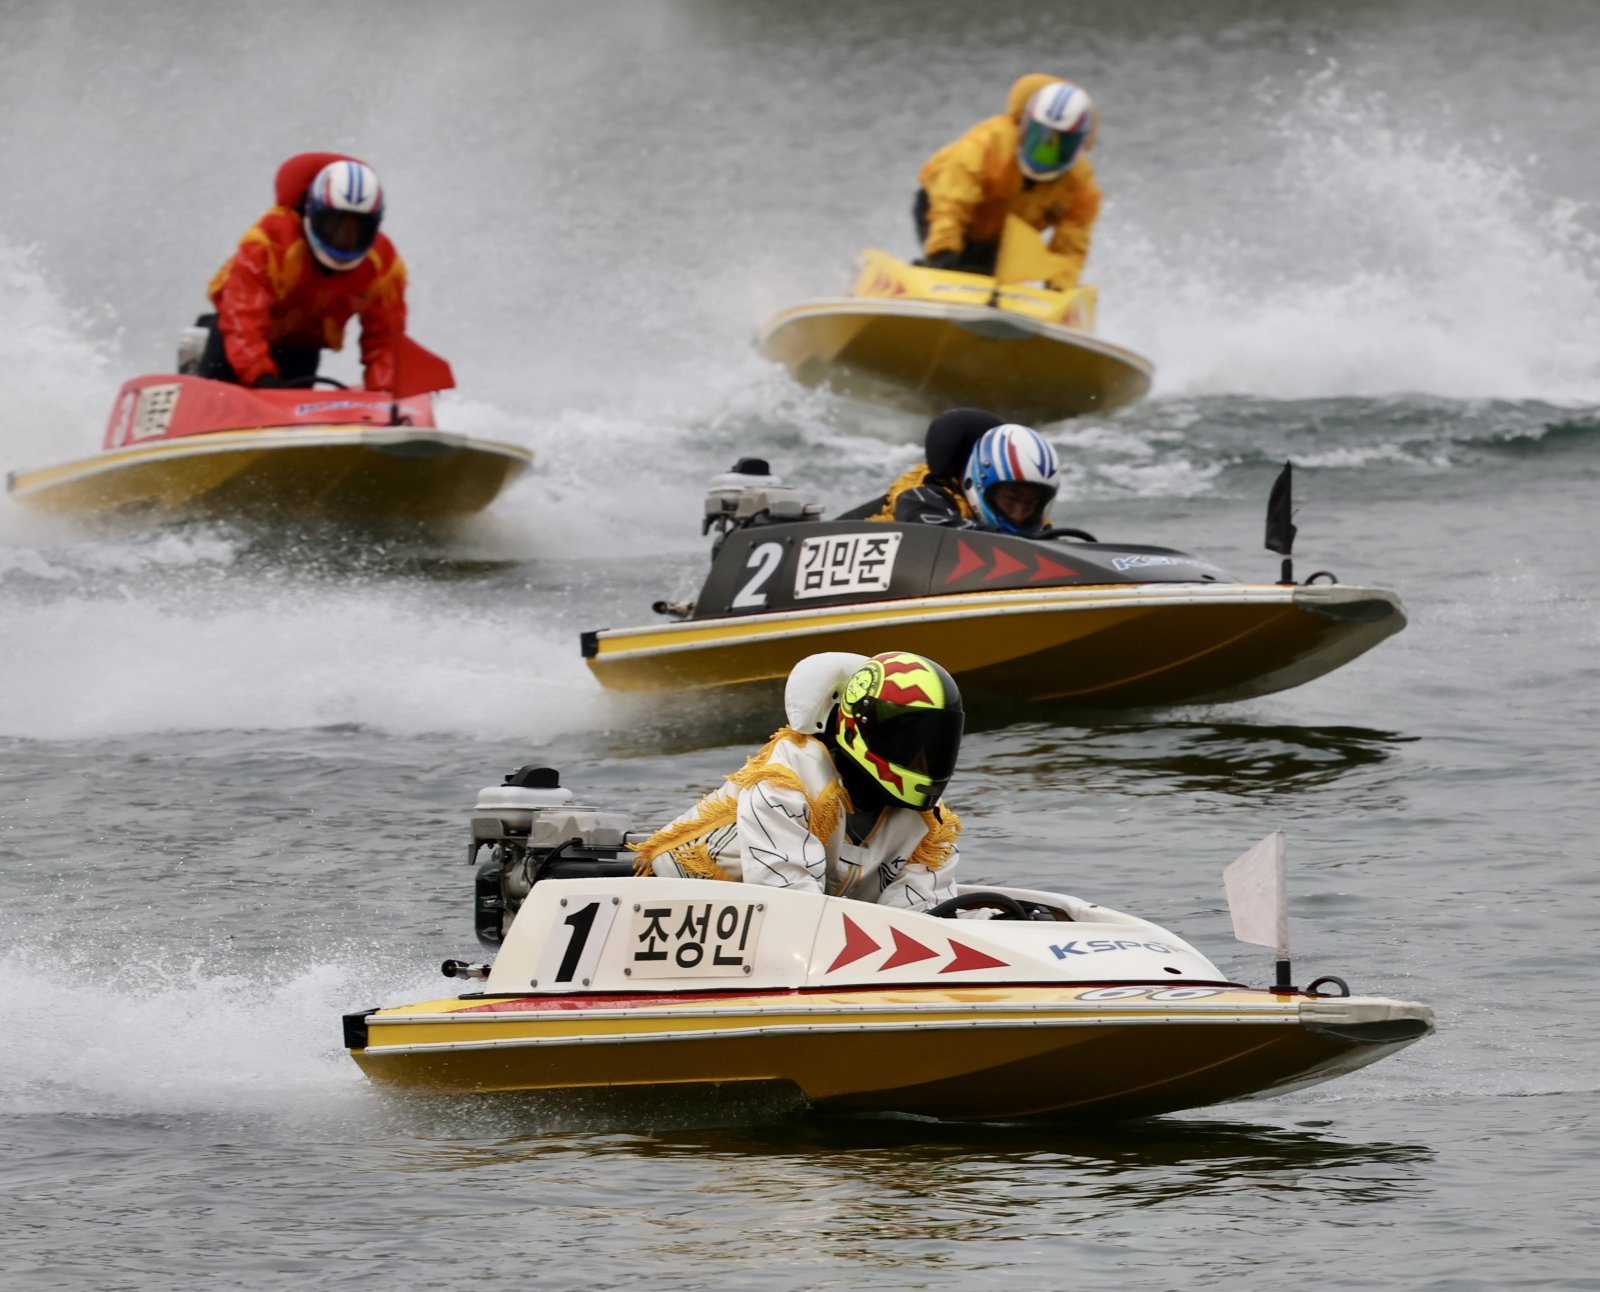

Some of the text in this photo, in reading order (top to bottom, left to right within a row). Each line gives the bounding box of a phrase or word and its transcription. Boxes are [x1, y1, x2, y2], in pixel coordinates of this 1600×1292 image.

[732, 542, 784, 608] 2
[804, 538, 889, 590] 김민준
[555, 902, 600, 982] 1
[634, 904, 754, 968] 조성인
